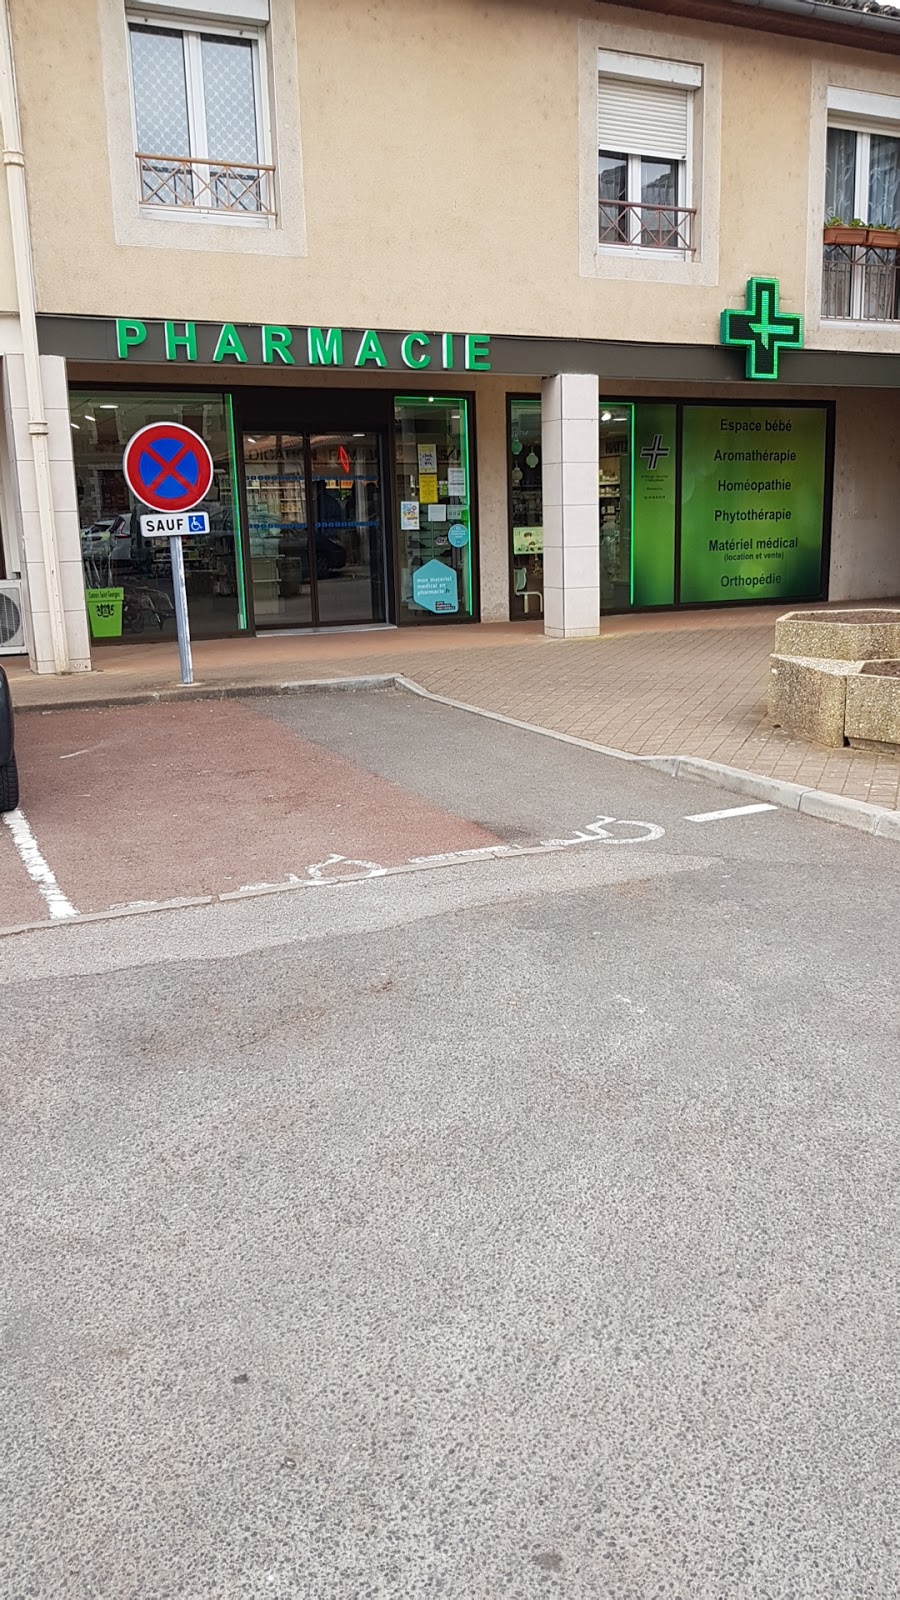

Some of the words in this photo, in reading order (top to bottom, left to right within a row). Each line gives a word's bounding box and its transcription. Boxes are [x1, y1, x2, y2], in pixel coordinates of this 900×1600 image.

[115, 318, 492, 371] PHARMACIE
[720, 419, 762, 432] Espace
[765, 419, 792, 431] bébé
[714, 449, 797, 464] Aromathérapie
[718, 479, 791, 493] Homéopathie
[714, 508, 792, 524] Phytothérapie
[146, 518, 184, 532] SAUF
[709, 538, 753, 551] Matériel
[756, 537, 798, 549] médical
[723, 553, 754, 563] (location
[755, 552, 762, 560] et
[763, 551, 785, 560] vente)
[721, 573, 782, 588] Orthopédie
